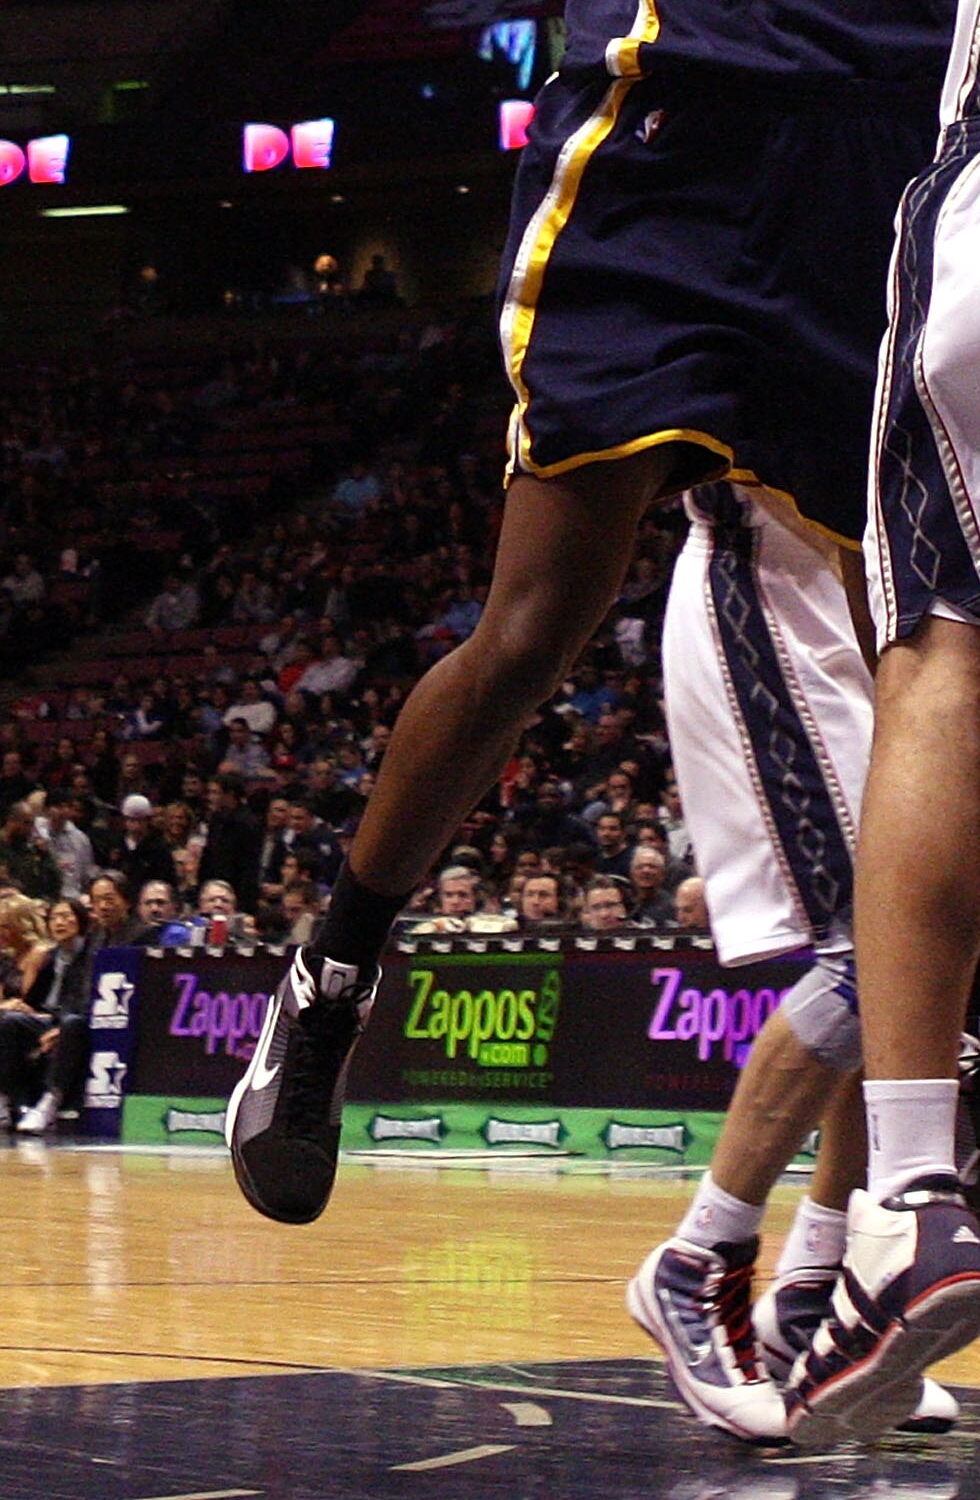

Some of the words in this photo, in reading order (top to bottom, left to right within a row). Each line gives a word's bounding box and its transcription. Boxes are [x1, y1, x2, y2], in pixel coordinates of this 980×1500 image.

[243, 117, 335, 173] DE
[404, 969, 536, 1059] Zappos
[648, 967, 793, 1062] Zappo
